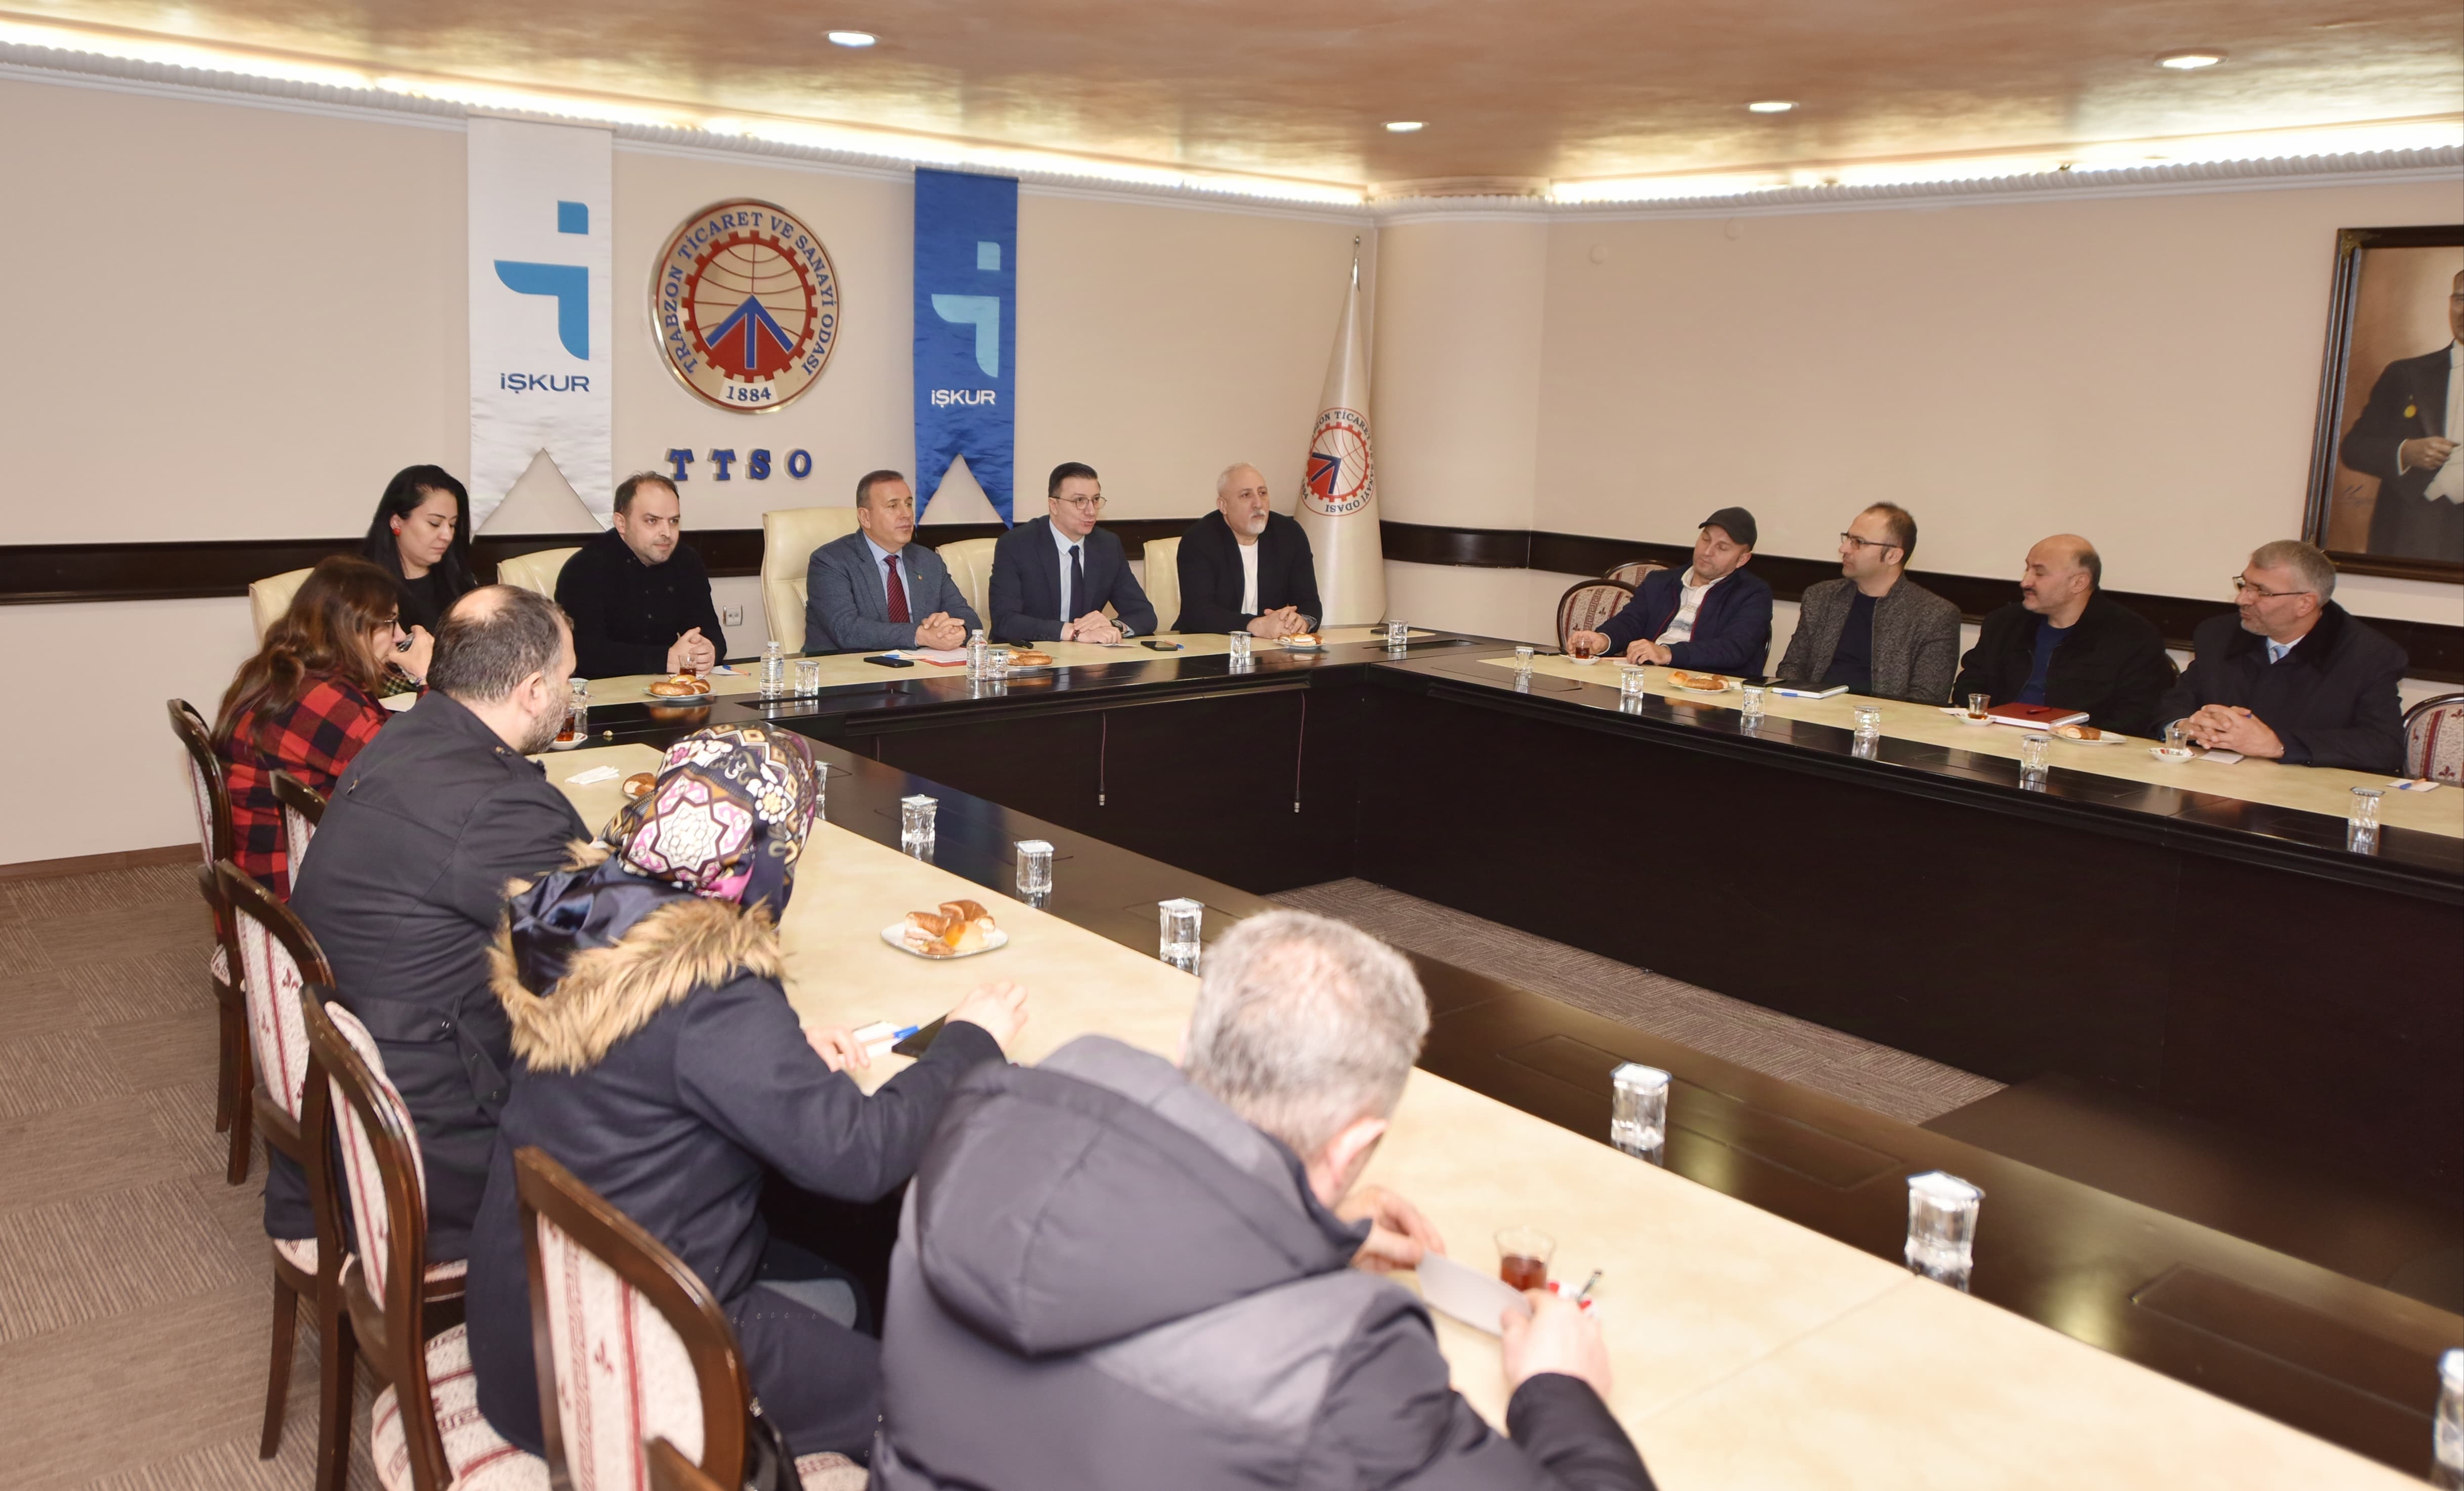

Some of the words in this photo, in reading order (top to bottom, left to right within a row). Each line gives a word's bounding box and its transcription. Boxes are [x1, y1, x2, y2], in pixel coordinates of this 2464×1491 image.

[678, 211, 762, 260] TİCARET
[770, 216, 794, 239] VE
[795, 235, 837, 307] SANAYİ
[664, 265, 698, 374] TRABZON
[801, 314, 834, 375] ODASI
[726, 386, 771, 402] 1884
[1325, 499, 1360, 513] ODASI
